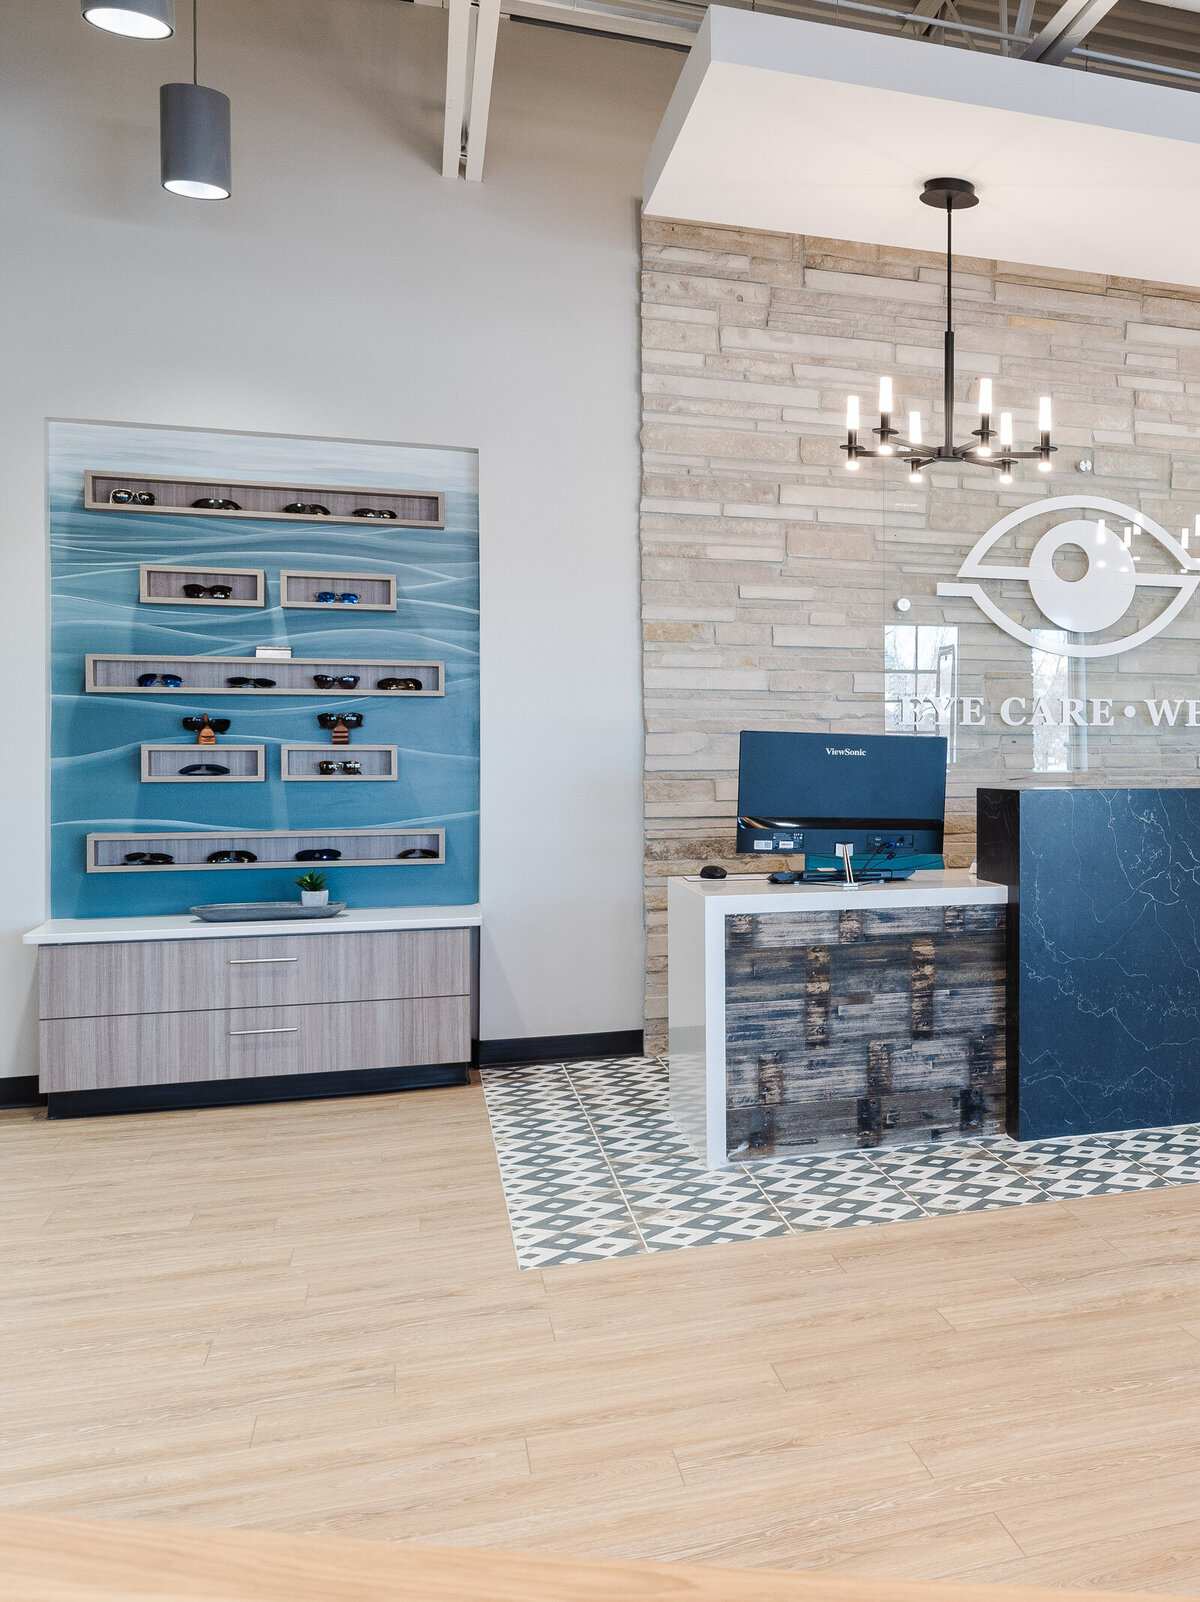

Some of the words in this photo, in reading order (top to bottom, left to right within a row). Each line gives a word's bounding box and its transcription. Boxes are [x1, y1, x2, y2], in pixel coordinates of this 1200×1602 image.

[901, 696, 986, 726] EYE
[1000, 697, 1115, 726] CARE
[825, 747, 866, 756] ViewSonic
